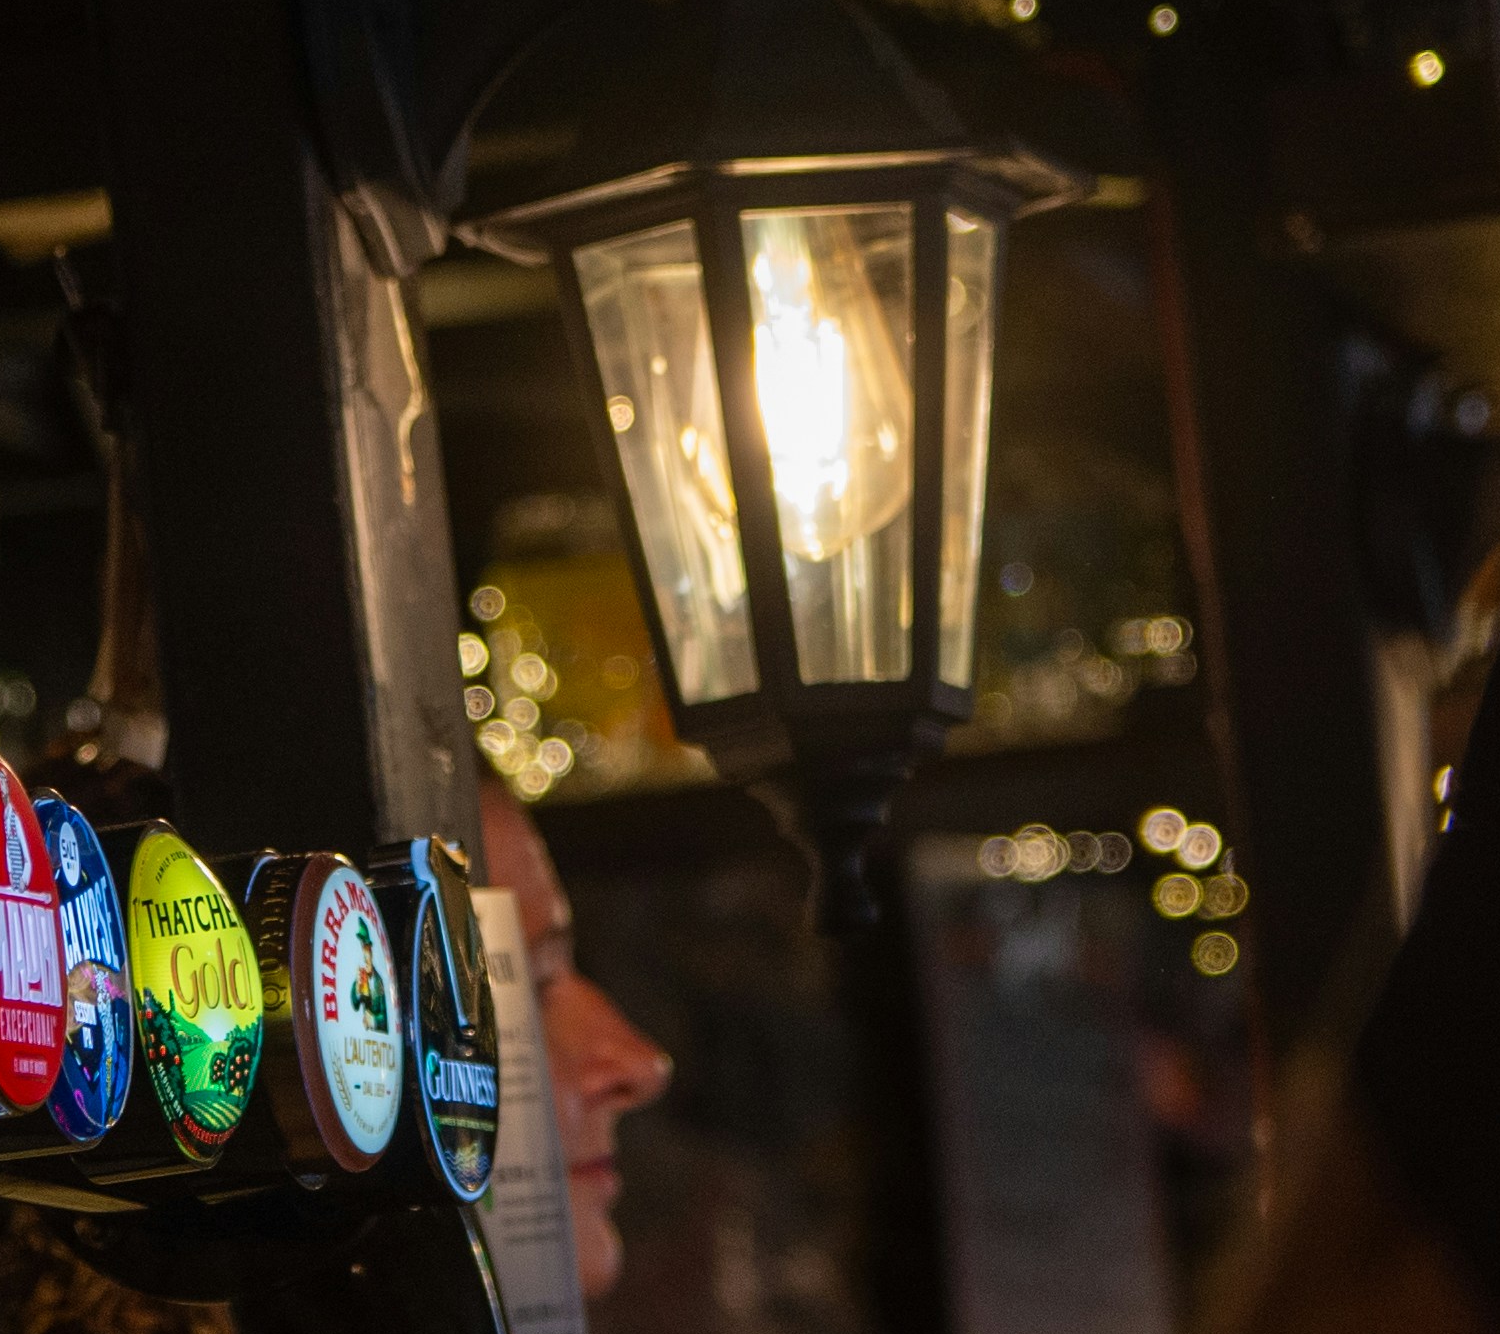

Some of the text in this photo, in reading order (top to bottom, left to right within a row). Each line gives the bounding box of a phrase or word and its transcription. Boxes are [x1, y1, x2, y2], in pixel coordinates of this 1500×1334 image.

[59, 875, 121, 974] CALYPSE
[140, 893, 240, 940] THATCHE
[320, 888, 350, 1024] BIRRA
[170, 934, 256, 1019] Gold
[425, 1048, 497, 1108] GUINNESS
